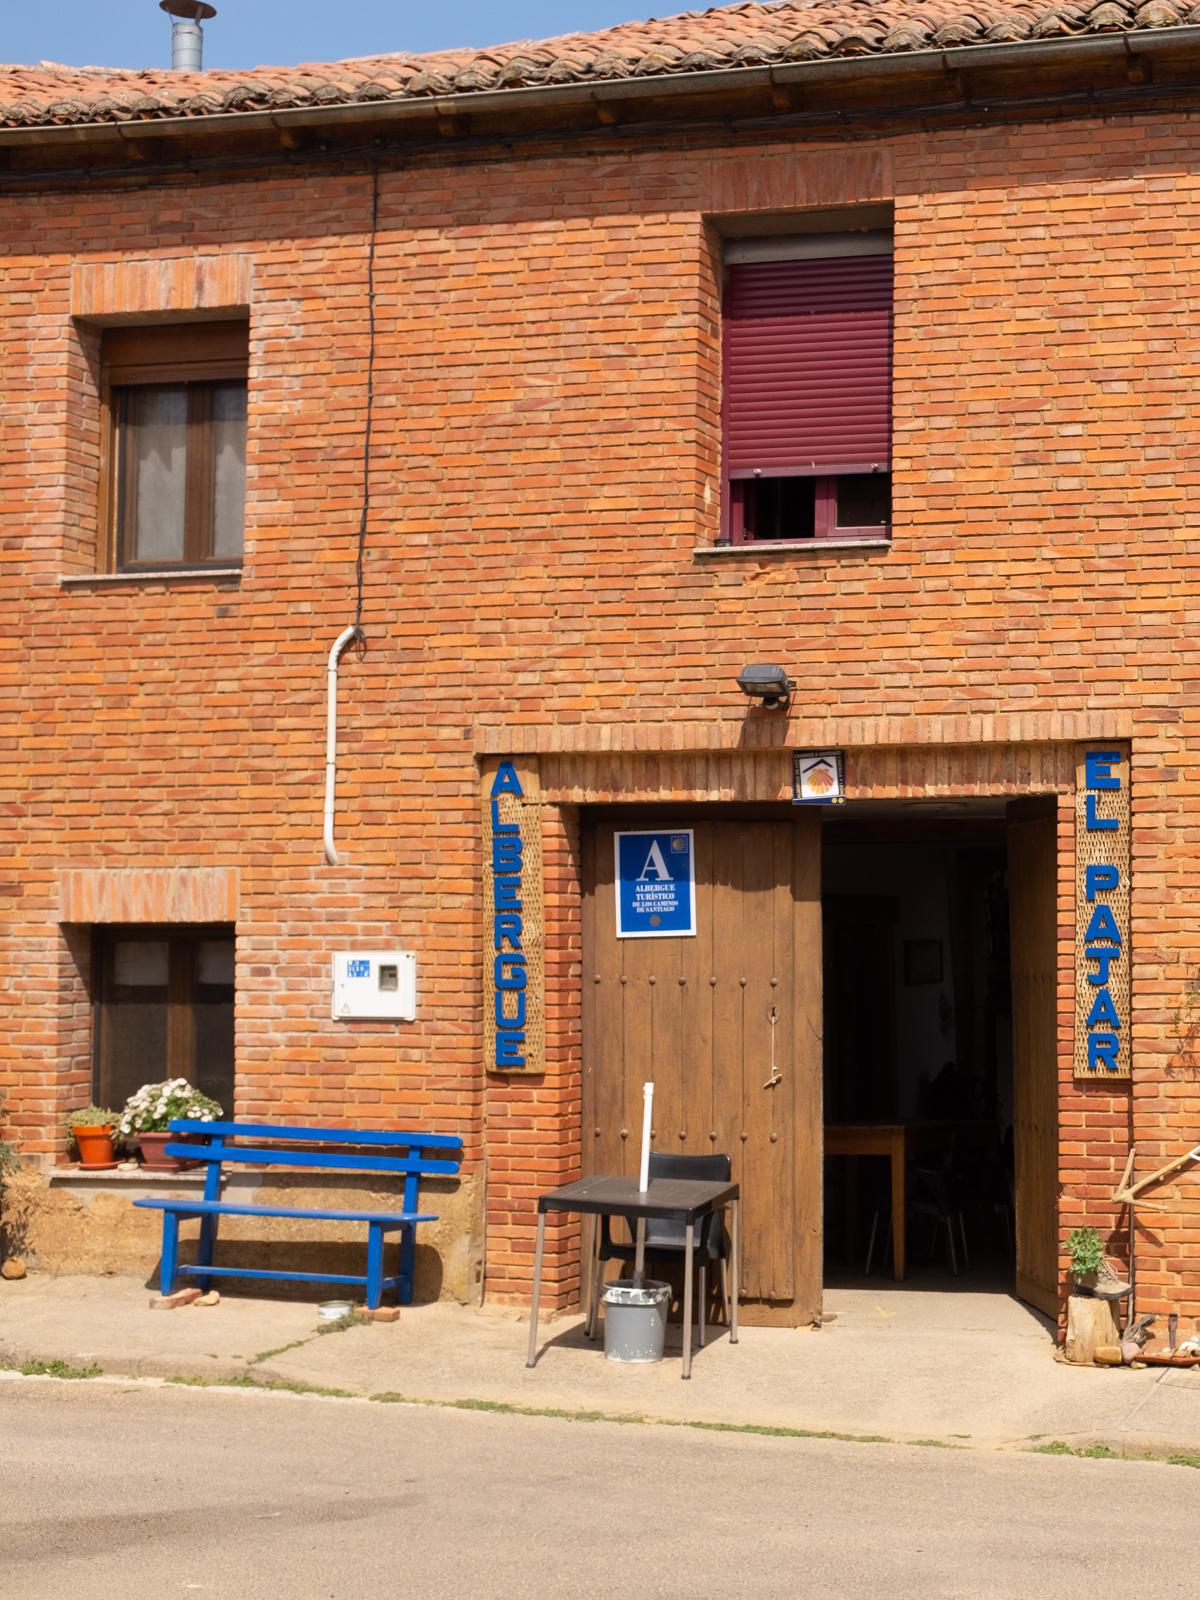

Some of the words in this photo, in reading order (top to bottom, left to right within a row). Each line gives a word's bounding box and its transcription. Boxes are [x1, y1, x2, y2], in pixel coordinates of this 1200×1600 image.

[1085, 751, 1121, 830] EL
[635, 839, 674, 881] A
[635, 884, 676, 892] ALBERGUE
[490, 761, 527, 1067] ALBERGUE
[636, 891, 675, 901] TURÍSTICO
[1084, 865, 1121, 1070] PAJAR
